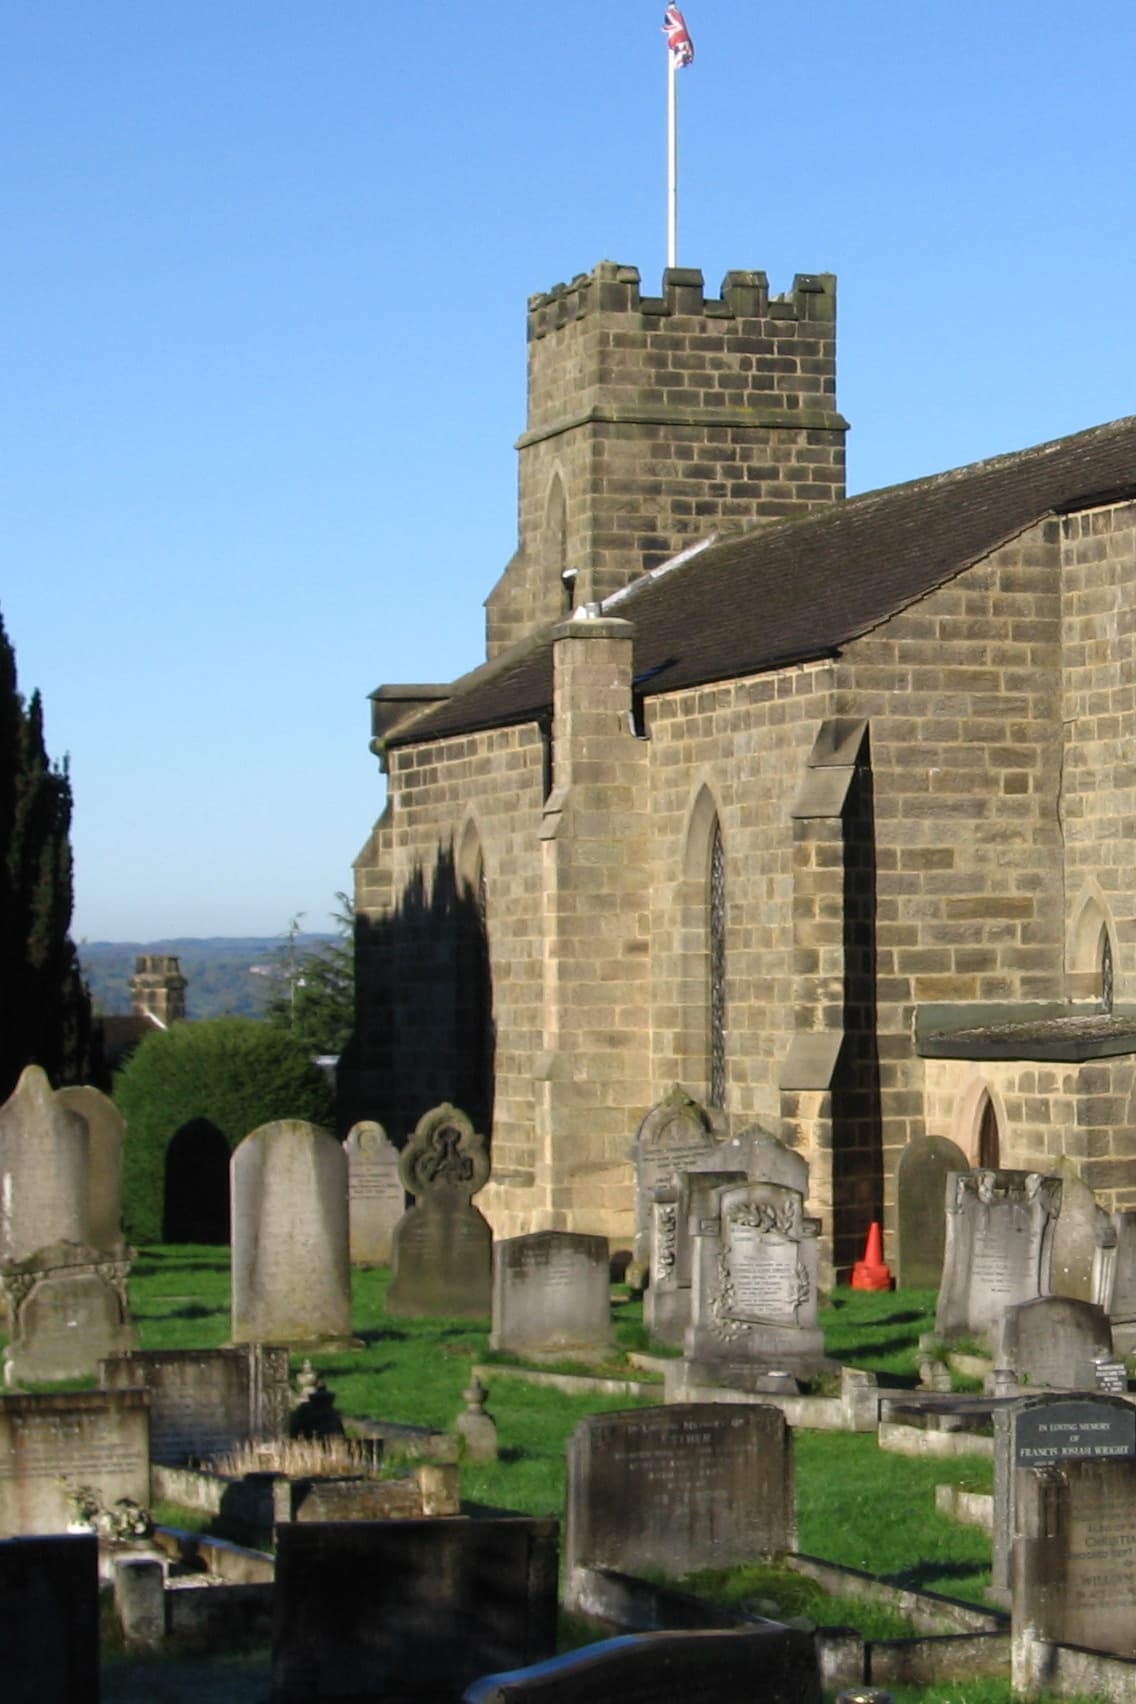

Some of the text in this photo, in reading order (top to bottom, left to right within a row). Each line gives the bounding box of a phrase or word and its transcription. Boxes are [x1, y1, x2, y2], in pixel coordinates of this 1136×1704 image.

[1038, 1422, 1111, 1432] IN LOVING MEMORY
[1020, 1447, 1058, 1457] FRANCIS
[1094, 1445, 1129, 1455] WRIGHT
